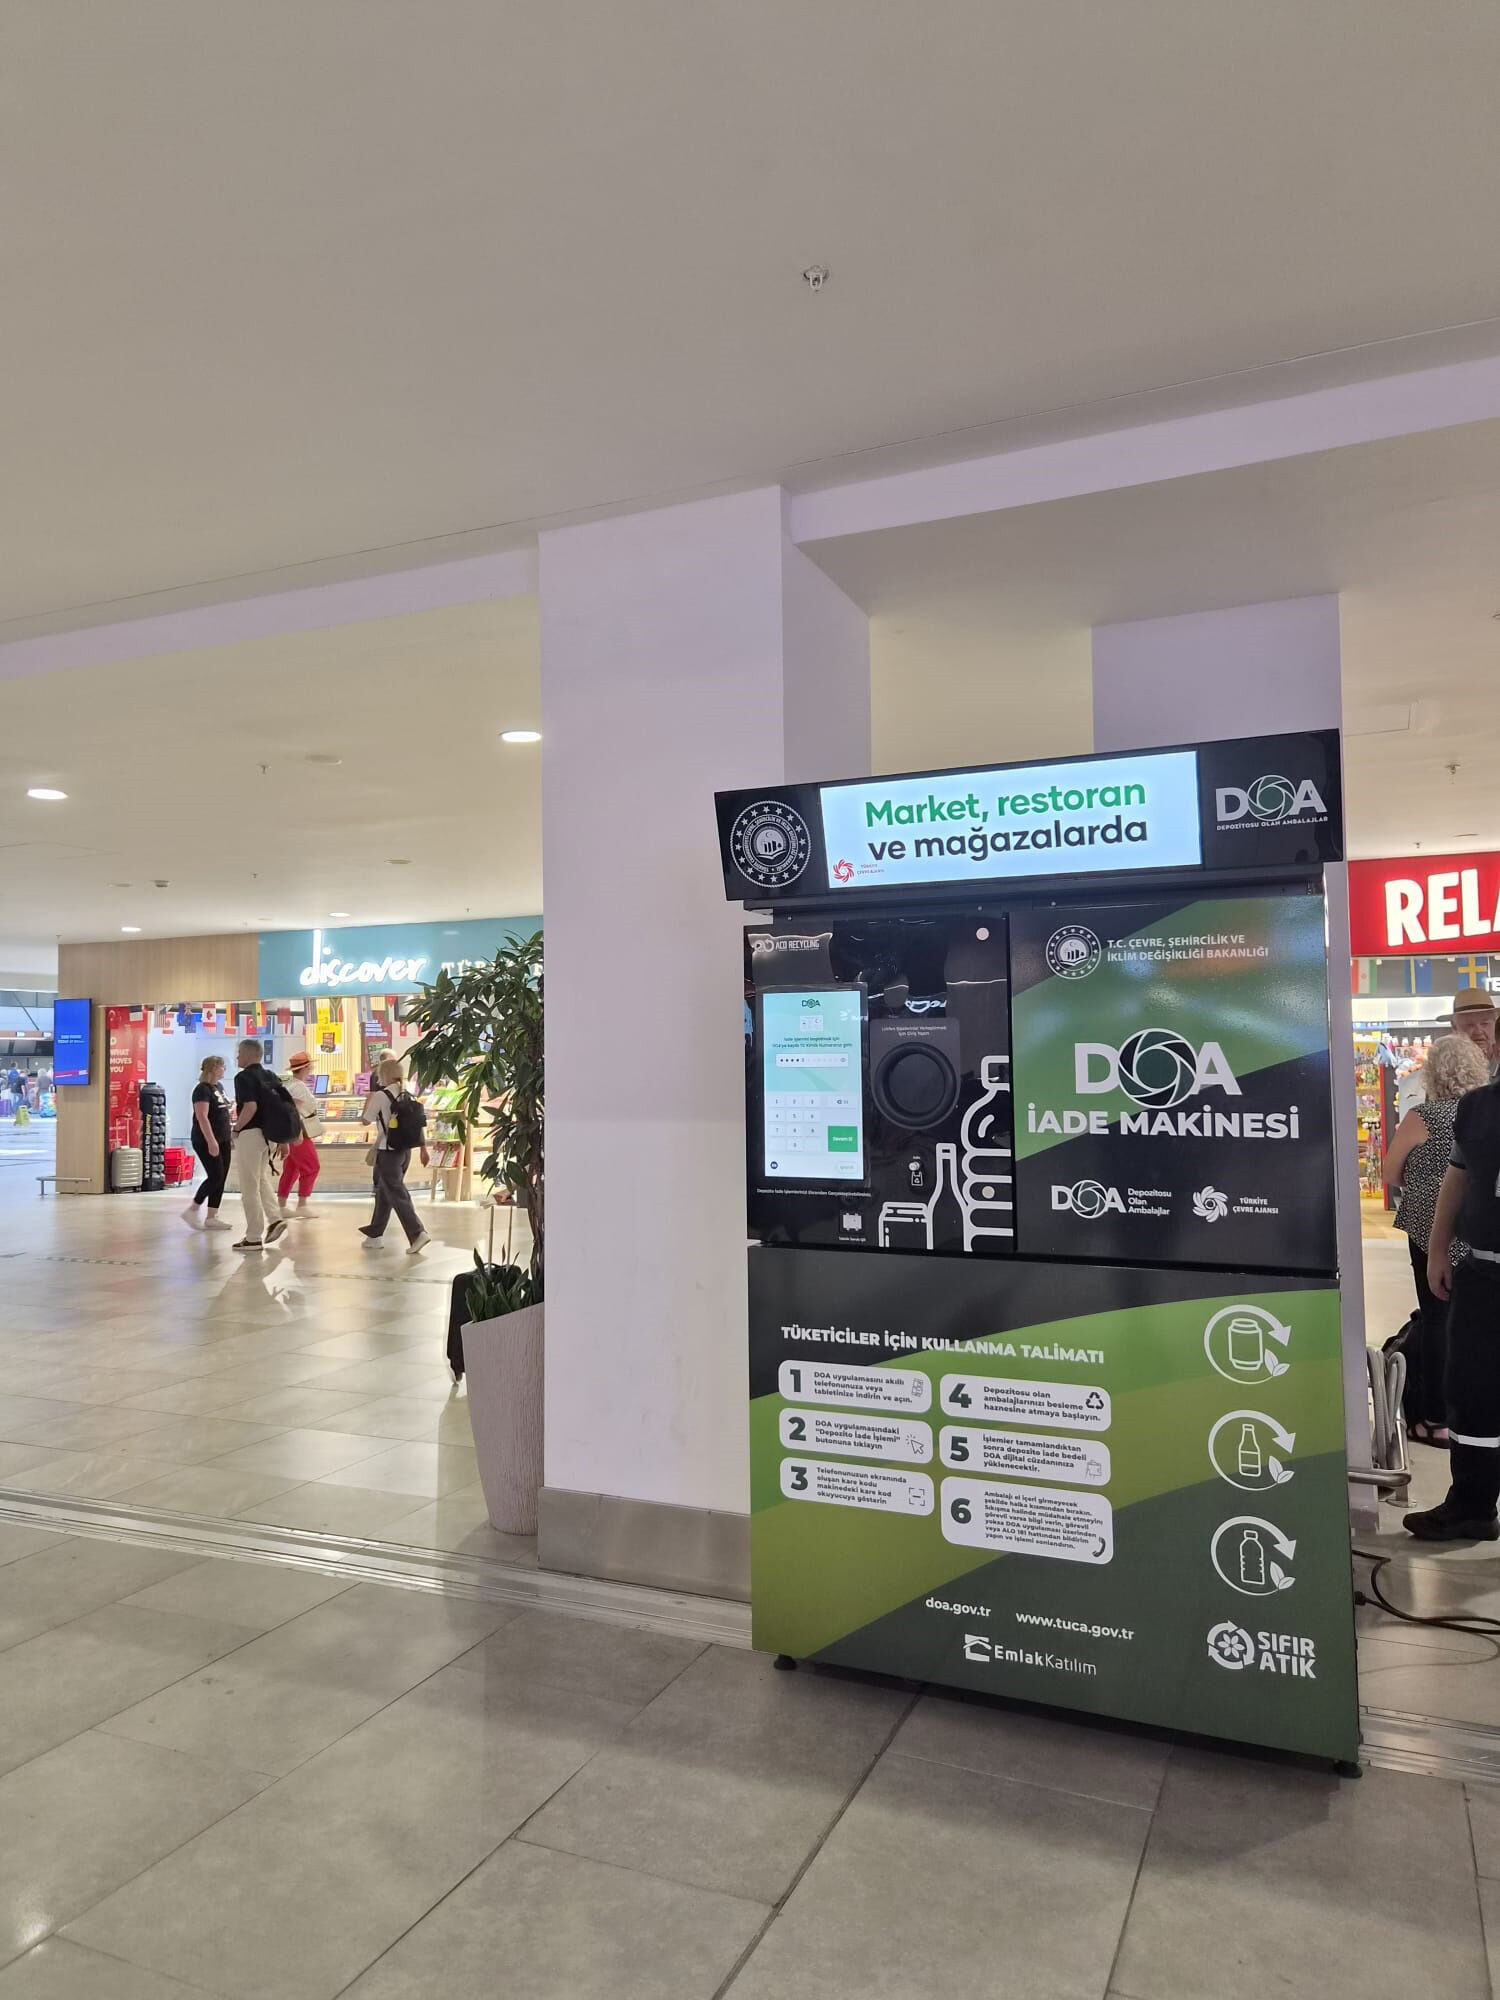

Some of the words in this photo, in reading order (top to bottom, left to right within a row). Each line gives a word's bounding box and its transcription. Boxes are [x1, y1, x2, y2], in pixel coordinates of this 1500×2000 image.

[865, 794, 989, 827] Market,
[998, 783, 1146, 816] restoran
[1216, 774, 1328, 821] DOA
[1216, 822, 1260, 831] DEPOZİTOSU
[1261, 820, 1281, 828] OLAN
[1282, 816, 1329, 825] AMBALAJLAR
[868, 840, 906, 861] ve
[914, 815, 1148, 861] mağazalarda
[1384, 868, 1500, 947] REL
[788, 939, 820, 949] RECYCLING
[1107, 939, 1127, 948] T.C.
[1129, 937, 1166, 950] ÇEVRE,
[1168, 933, 1228, 949] ŞEHİRCİLİK
[1230, 934, 1245, 944] VE
[300, 929, 427, 987] discover
[1107, 949, 1137, 962] İKLİM
[1139, 946, 1204, 962] DEĞİŞİKLİĞİ
[1207, 944, 1269, 958] BAKANLIĞI
[110, 1057, 132, 1065] MOVES
[1074, 1028, 1243, 1109] DOA
[1027, 1102, 1110, 1135] İADE
[1120, 1104, 1300, 1139] MAKİNESİ
[1051, 1179, 1126, 1219] DOA
[1127, 1188, 1172, 1198] Depozitosu
[1127, 1197, 1147, 1205] Olan
[1239, 1196, 1268, 1205] TÜRKİYE
[1128, 1205, 1171, 1216] Ambalajlar
[1233, 1205, 1253, 1214] ÇEVRE
[1254, 1206, 1279, 1214] AJANSI
[781, 1324, 881, 1346] TÜKETİCİLER
[884, 1330, 918, 1351] İÇİN
[921, 1337, 1017, 1357] KULLANMA
[1020, 1343, 1105, 1364] TALİMATI
[789, 1368, 802, 1393] 1
[814, 1371, 831, 1379] DOA
[832, 1373, 884, 1385] uygulamasını
[885, 1377, 905, 1386] akıllı
[814, 1380, 864, 1390] telefonunuza
[865, 1384, 883, 1392] veya
[814, 1388, 854, 1398] tabletinize
[855, 1391, 881, 1401] indirin
[893, 1396, 913, 1404] açın.
[948, 1382, 973, 1409] 4
[983, 1386, 1031, 1397] Depozitosu
[1032, 1390, 1051, 1398] olan
[983, 1394, 1046, 1407] ambalajlarınızı
[1047, 1400, 1084, 1411] besleme
[983, 1403, 1026, 1414] haznesine
[1028, 1408, 1060, 1418] atmaya
[1061, 1410, 1101, 1422] başlayın.
[788, 1416, 807, 1442] 2
[815, 1419, 832, 1427] DOA
[833, 1421, 900, 1435] uygulamasındaki
[854, 1431, 871, 1440] İade
[816, 1436, 852, 1445] butonuna
[853, 1440, 883, 1450] tıklayın
[949, 1435, 970, 1462] 5
[982, 1434, 1014, 1446] İşlemler
[1015, 1439, 1082, 1452] tamamlandıktan
[983, 1443, 1005, 1452] sonra
[1006, 1446, 1041, 1457] depozito
[1061, 1451, 1087, 1461] bedeli
[983, 1452, 1001, 1460] DOA
[1002, 1453, 1026, 1463] dijital
[1026, 1456, 1075, 1468] cüzdanınıza
[983, 1459, 1041, 1473] yüklenecektir.
[790, 1465, 809, 1491] 3
[816, 1467, 868, 1479] Telefonunuzun
[870, 1473, 907, 1484] ekranında
[816, 1475, 840, 1484] oluşan
[841, 1477, 858, 1486] kare
[859, 1479, 878, 1488] kodu
[816, 1483, 859, 1493] makinedeki
[860, 1488, 876, 1496] kare
[877, 1489, 892, 1497] kod
[816, 1491, 856, 1501] okuyucuya
[950, 1497, 972, 1525] 6
[985, 1526, 1001, 1534] veya
[925, 1597, 992, 1617] doa.gov.tr
[1015, 1612, 1135, 1640] www.tuca.gov.tr
[1257, 1631, 1316, 1657] SIFIR
[994, 1644, 1097, 1676] EmlakKatılım
[1259, 1651, 1317, 1678] ATIK
